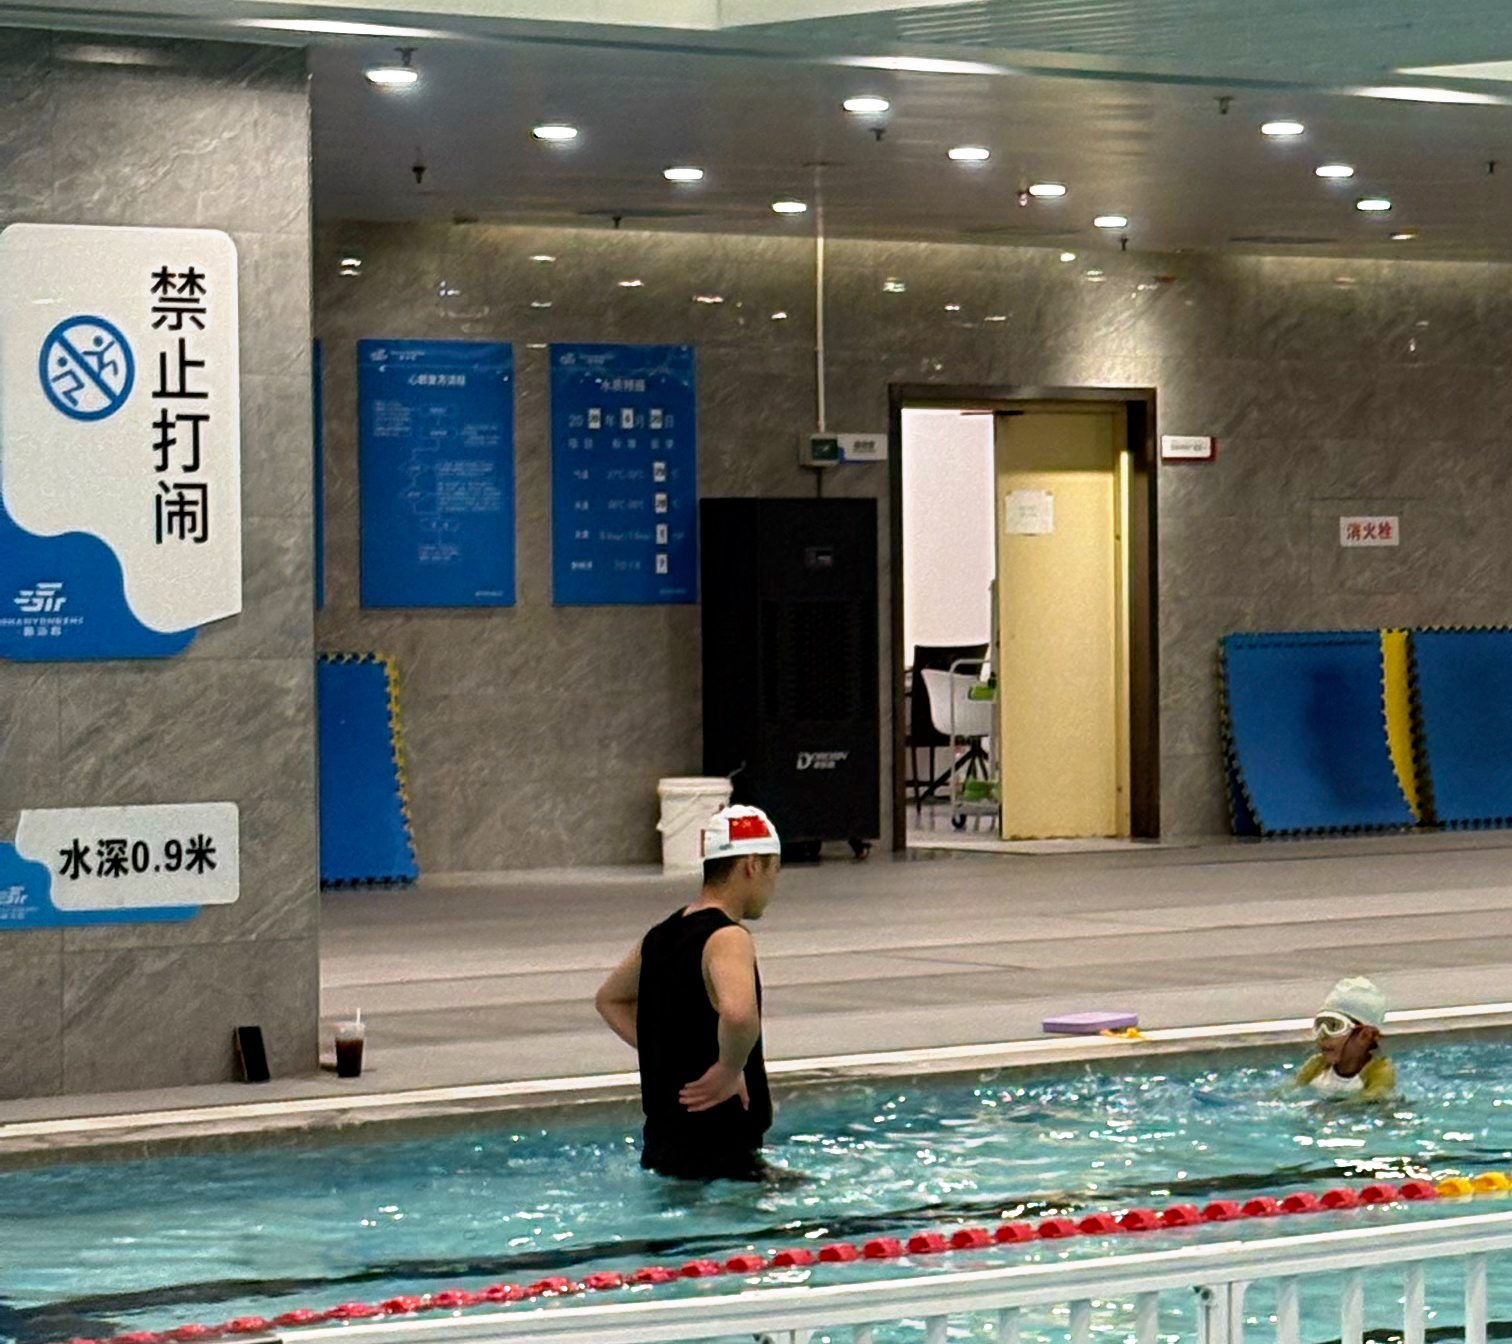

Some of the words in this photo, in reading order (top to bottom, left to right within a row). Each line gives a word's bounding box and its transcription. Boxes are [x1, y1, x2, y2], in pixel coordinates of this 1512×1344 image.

[150, 265, 210, 545] 禁止打闹
[1347, 520, 1393, 541] 消火栓
[59, 834, 217, 880] 水深0.9米
